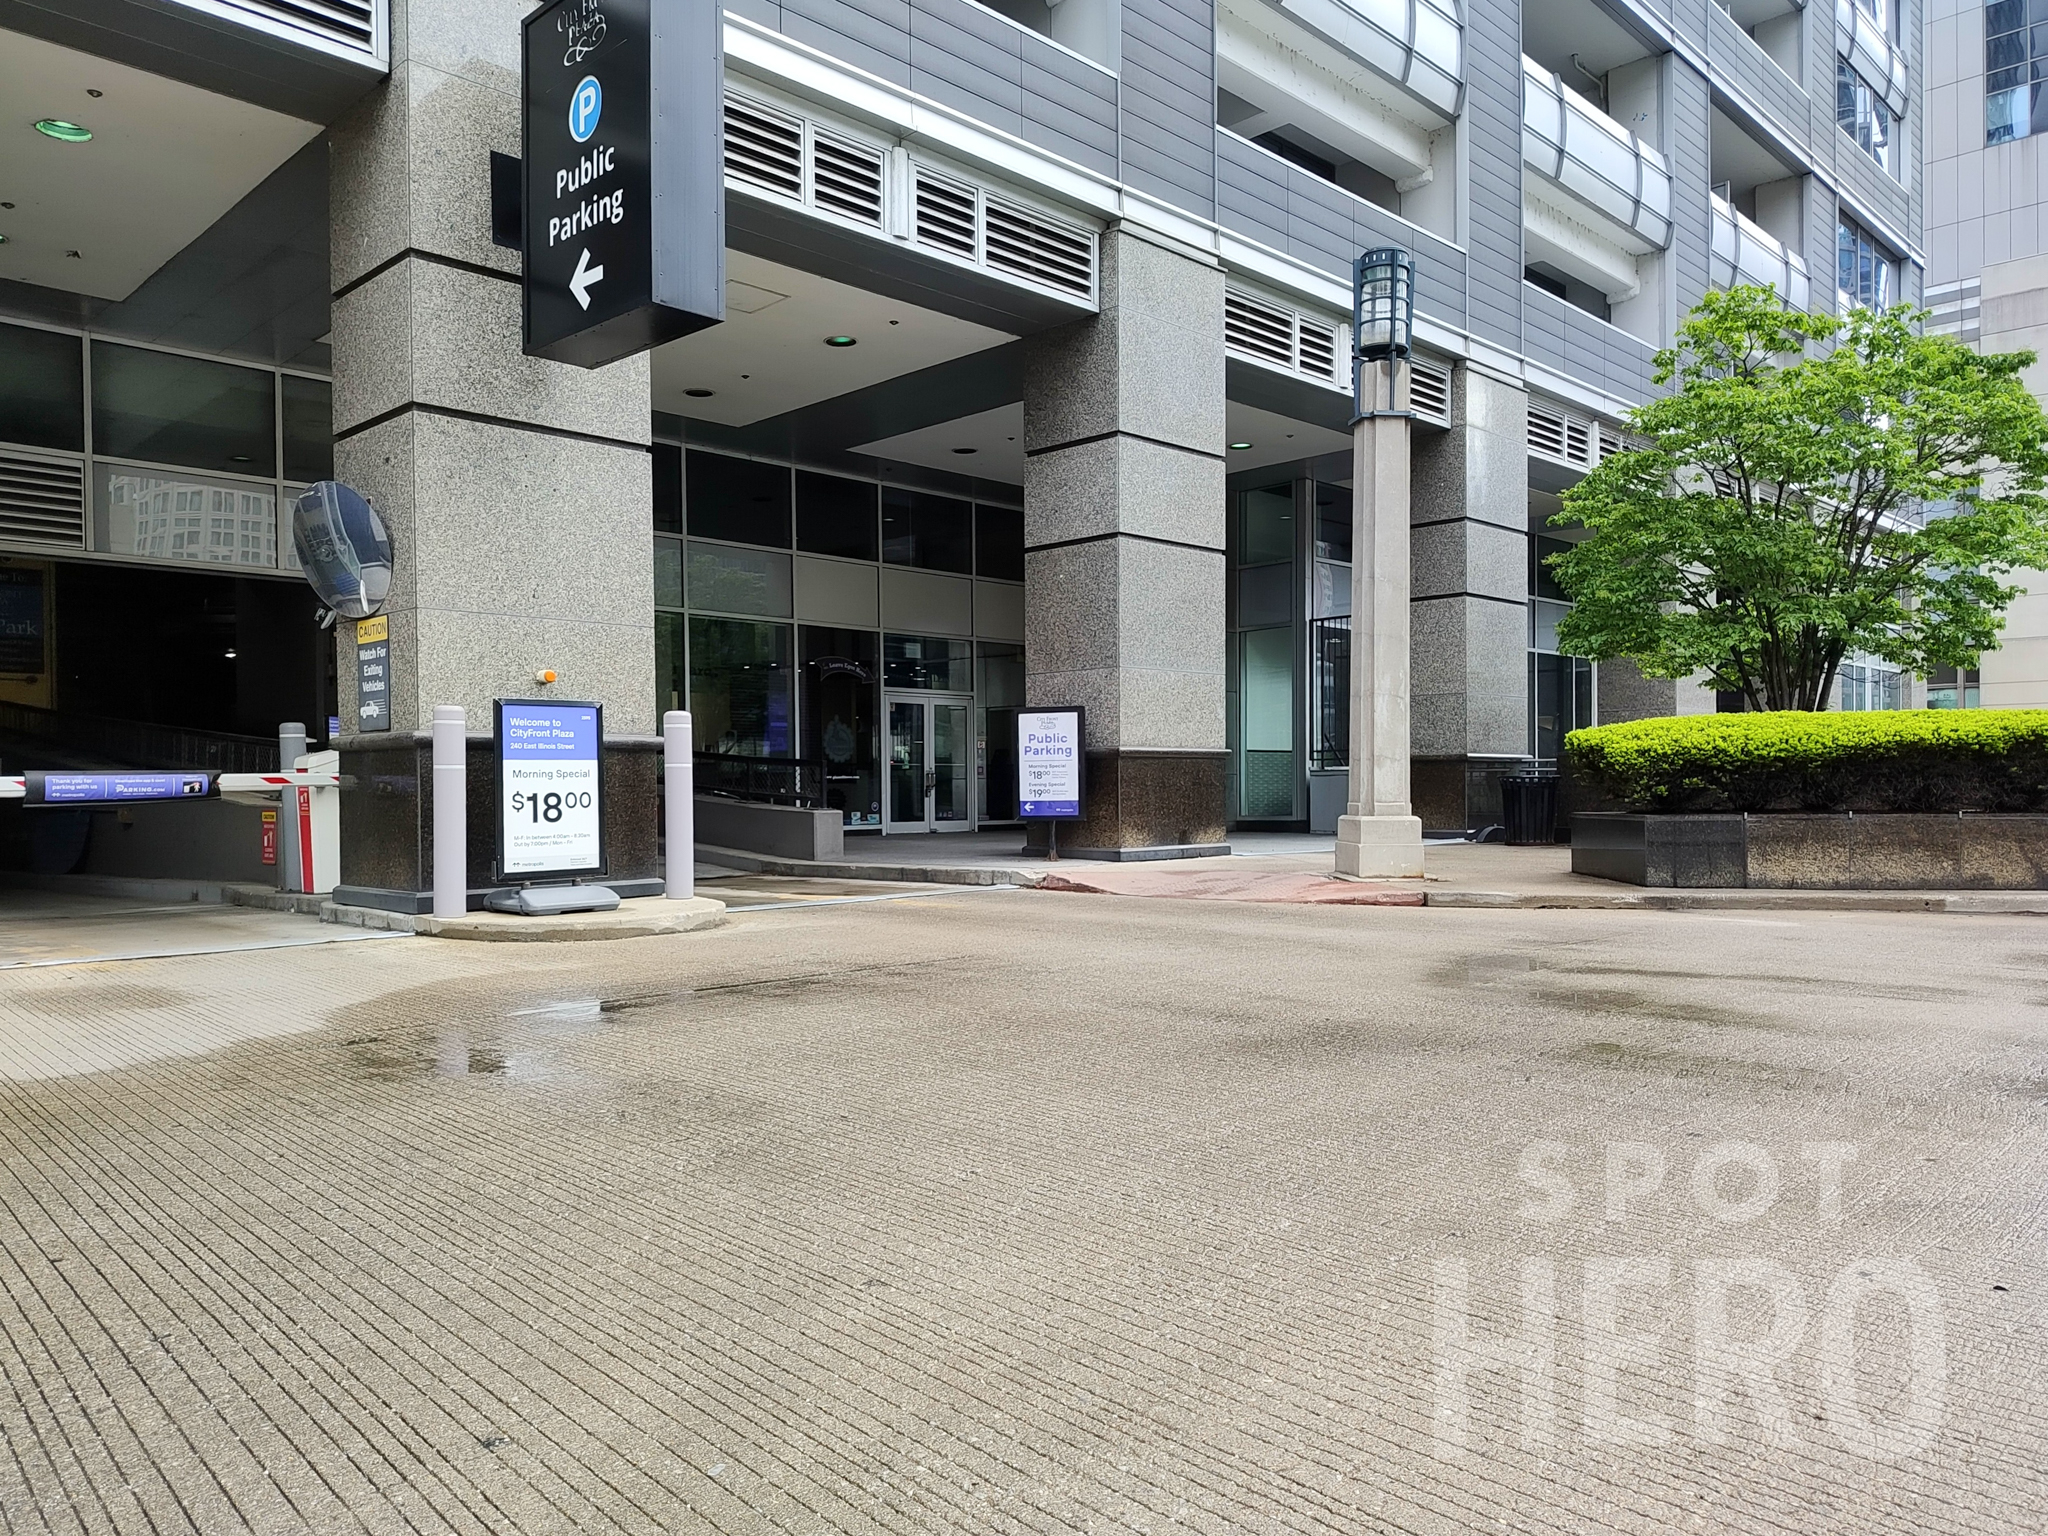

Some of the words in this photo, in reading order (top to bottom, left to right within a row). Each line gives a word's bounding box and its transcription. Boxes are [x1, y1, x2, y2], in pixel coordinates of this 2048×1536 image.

[556, 145, 615, 199] Public
[549, 188, 624, 247] Parking
[359, 622, 386, 638] CAUTION
[359, 648, 376, 661] Watch
[376, 646, 386, 658] For
[363, 664, 383, 677] Exiting
[362, 680, 385, 693] Vehicles
[509, 717, 550, 727] Welcome
[552, 719, 562, 727] to
[509, 728, 551, 739] CityFront
[552, 729, 575, 738] Plaza
[1028, 732, 1068, 744] Public
[510, 742, 523, 750] 240
[1024, 744, 1072, 758] Parking
[512, 769, 553, 781] Morning
[556, 769, 590, 780] Special
